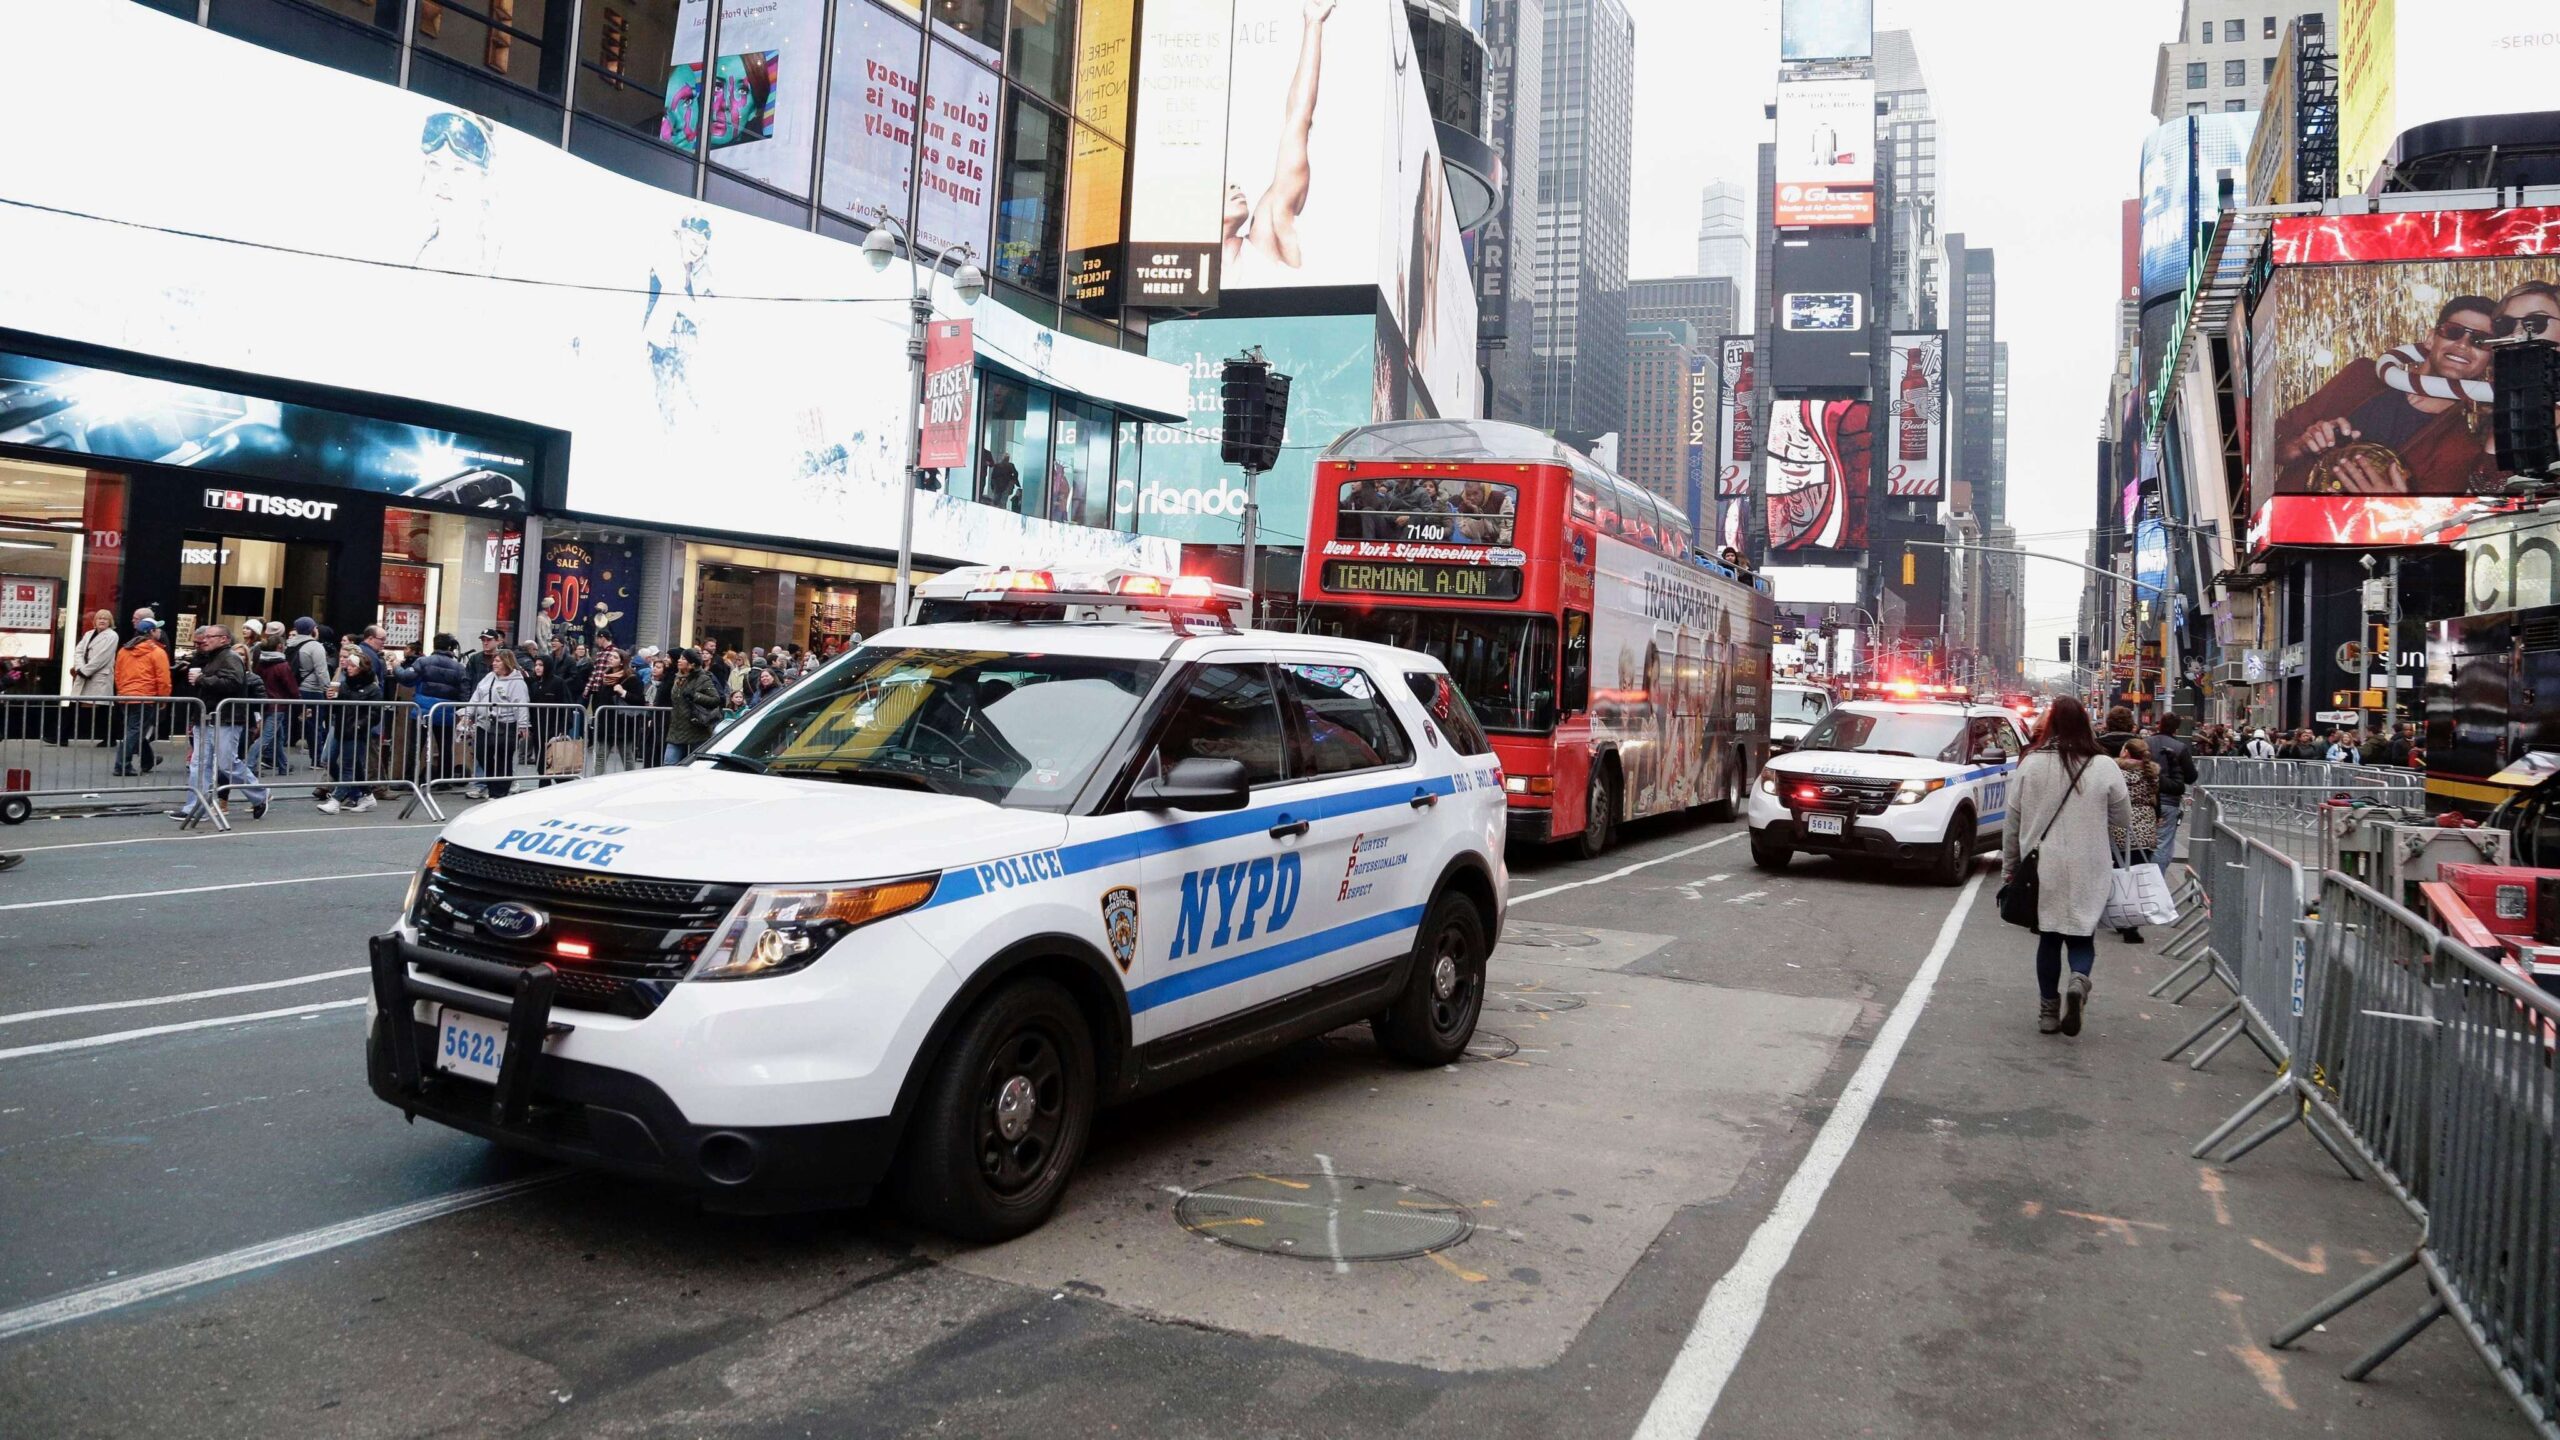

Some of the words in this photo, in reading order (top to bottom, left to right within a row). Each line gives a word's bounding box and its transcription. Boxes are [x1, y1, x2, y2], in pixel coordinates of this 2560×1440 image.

[1152, 254, 1179, 266] GET
[1136, 266, 1193, 280] TICKETS
[1142, 282, 1185, 294] HERE!
[1482, 314, 1500, 323] NYC
[926, 364, 973, 400] JERSEY
[930, 396, 964, 424] BOYS
[1689, 366, 1706, 446] NOVOTEL
[244, 493, 338, 521] TISSOT
[1115, 478, 1249, 516] Orlando
[546, 543, 592, 565] GALACTIC
[556, 558, 580, 569] SALE
[1322, 540, 1355, 555] New
[1358, 541, 1389, 557] York
[1391, 543, 1487, 565] Sightseeing
[1337, 565, 1430, 592] TERMINAL
[1644, 571, 1720, 634] TRANSPARENT
[1812, 766, 1861, 776] POLICE
[1812, 819, 1833, 830] 5612
[494, 829, 624, 867] POLICE
[977, 849, 1064, 894] POLICE
[1345, 853, 1408, 878] PROFESSIONALISM
[1108, 889, 1128, 902] POLICE
[1337, 880, 1373, 902] RESPECT
[490, 906, 528, 930] Ford
[1104, 898, 1136, 920] DEPARTMENT
[1168, 852, 1302, 961] NYPD
[2293, 940, 2305, 1013] NYPD
[445, 1025, 495, 1067] 5622
